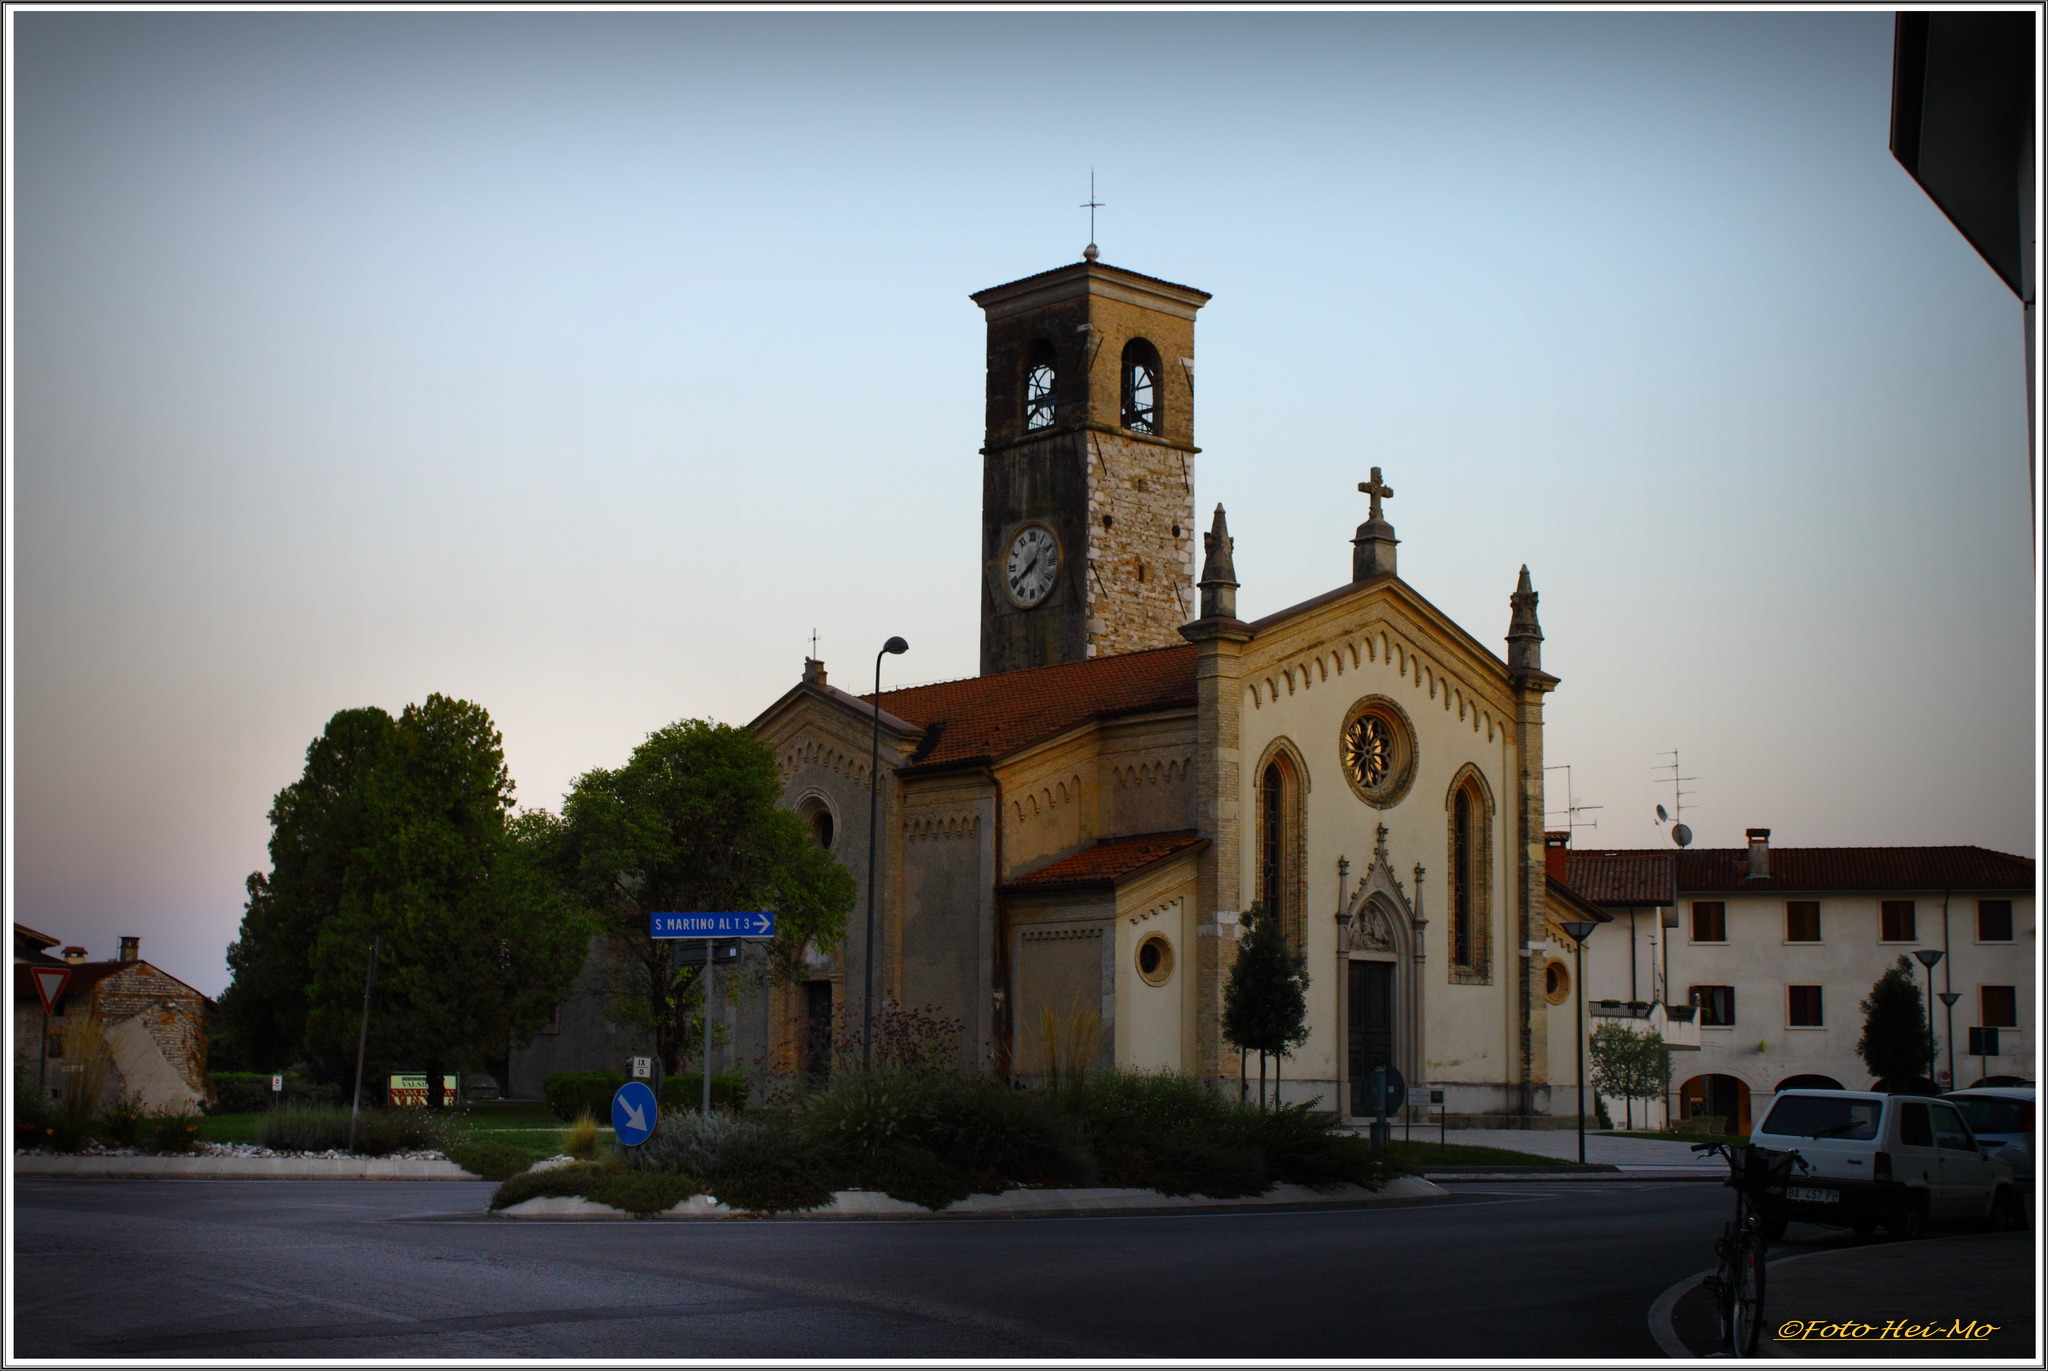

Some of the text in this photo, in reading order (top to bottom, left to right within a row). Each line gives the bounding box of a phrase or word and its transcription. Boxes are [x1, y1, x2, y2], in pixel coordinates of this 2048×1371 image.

[655, 918, 664, 931] S.
[667, 918, 715, 930] MARTINO
[718, 918, 731, 930] AL
[743, 917, 750, 930] 3
[638, 1059, 646, 1067] IX
